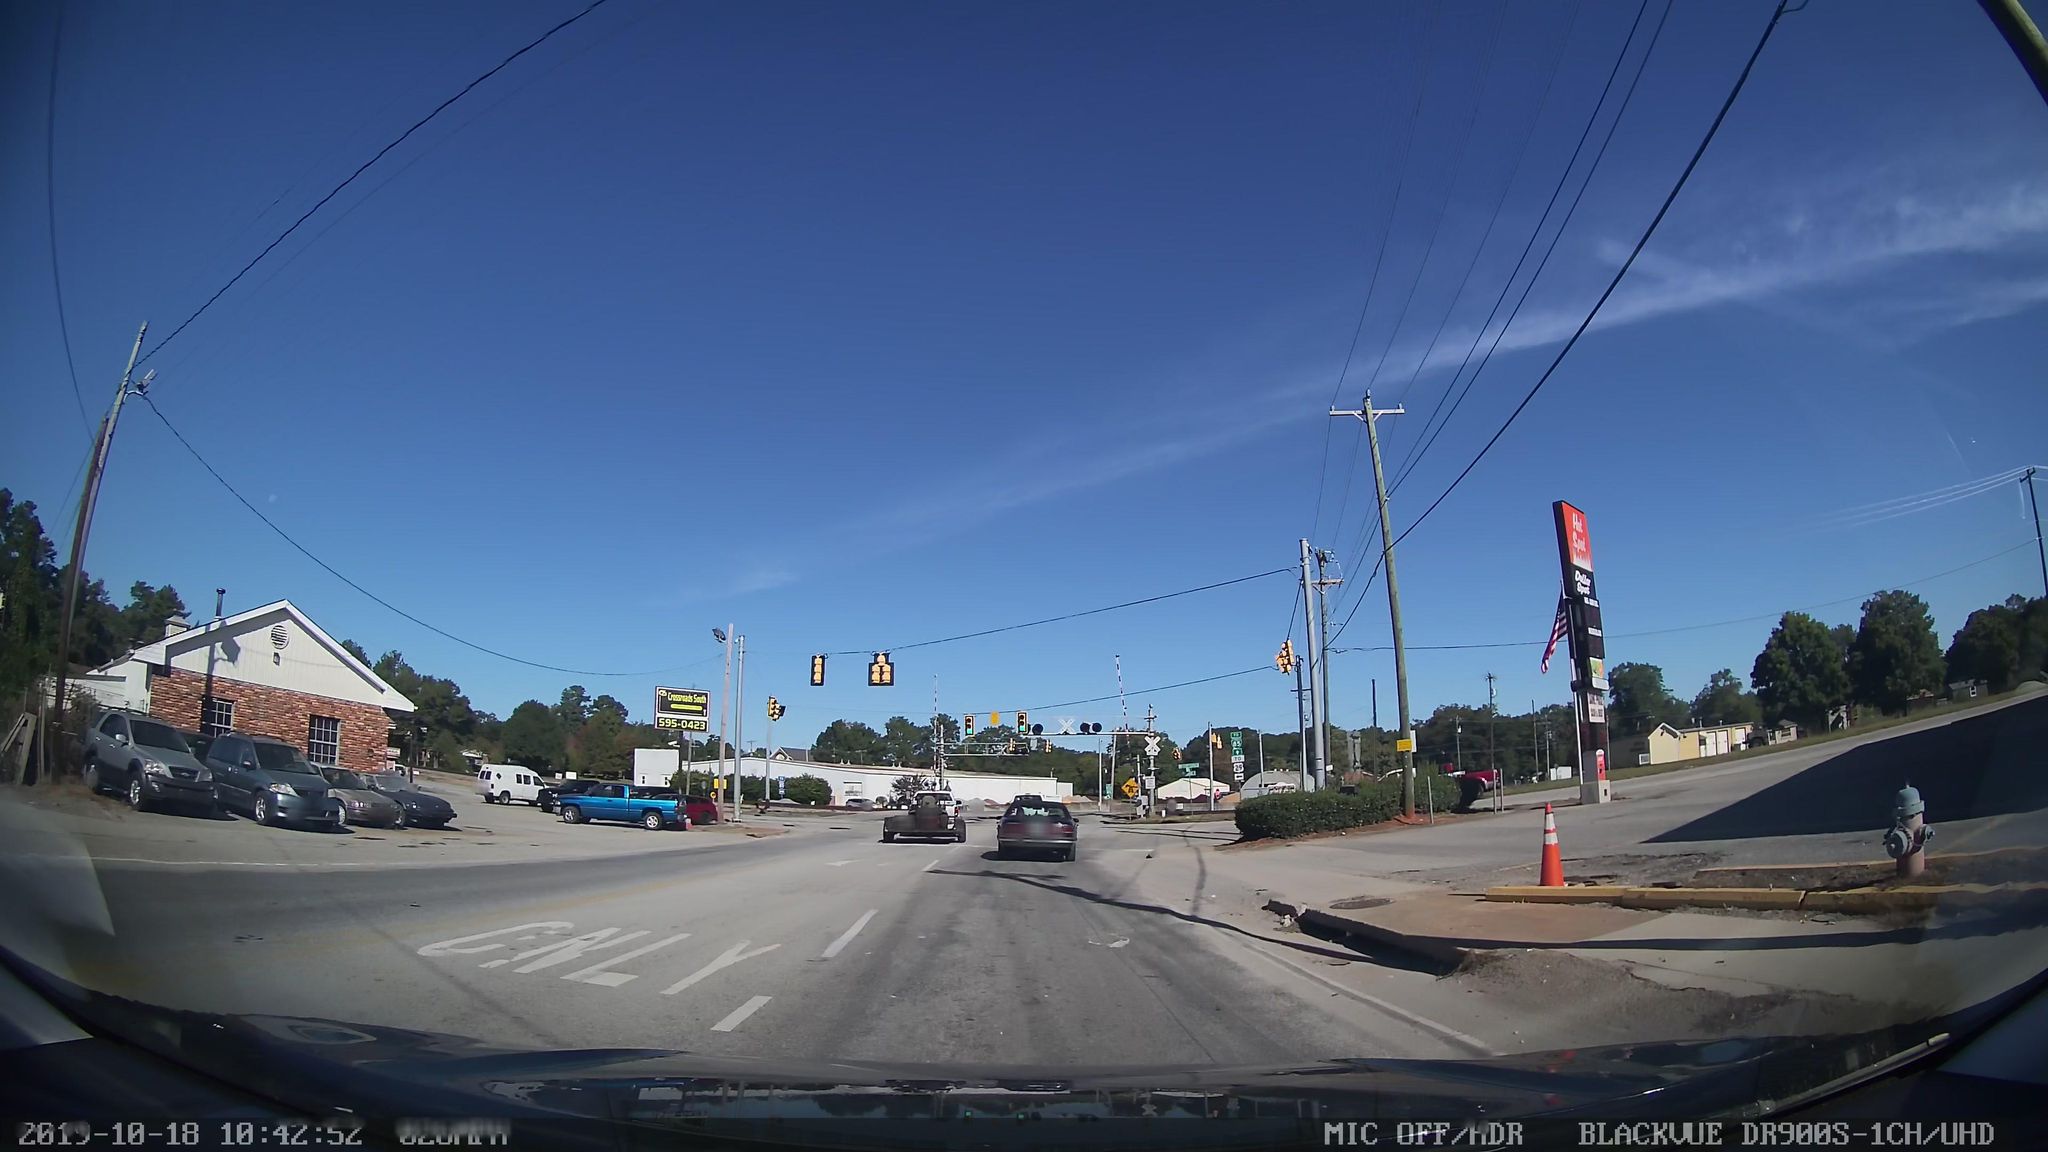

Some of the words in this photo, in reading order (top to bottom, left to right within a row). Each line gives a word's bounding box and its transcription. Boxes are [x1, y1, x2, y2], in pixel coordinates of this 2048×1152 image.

[668, 692, 693, 703] Crossroads
[694, 694, 706, 703] South
[659, 718, 706, 730] 595-0423
[417, 921, 781, 995] ONLY
